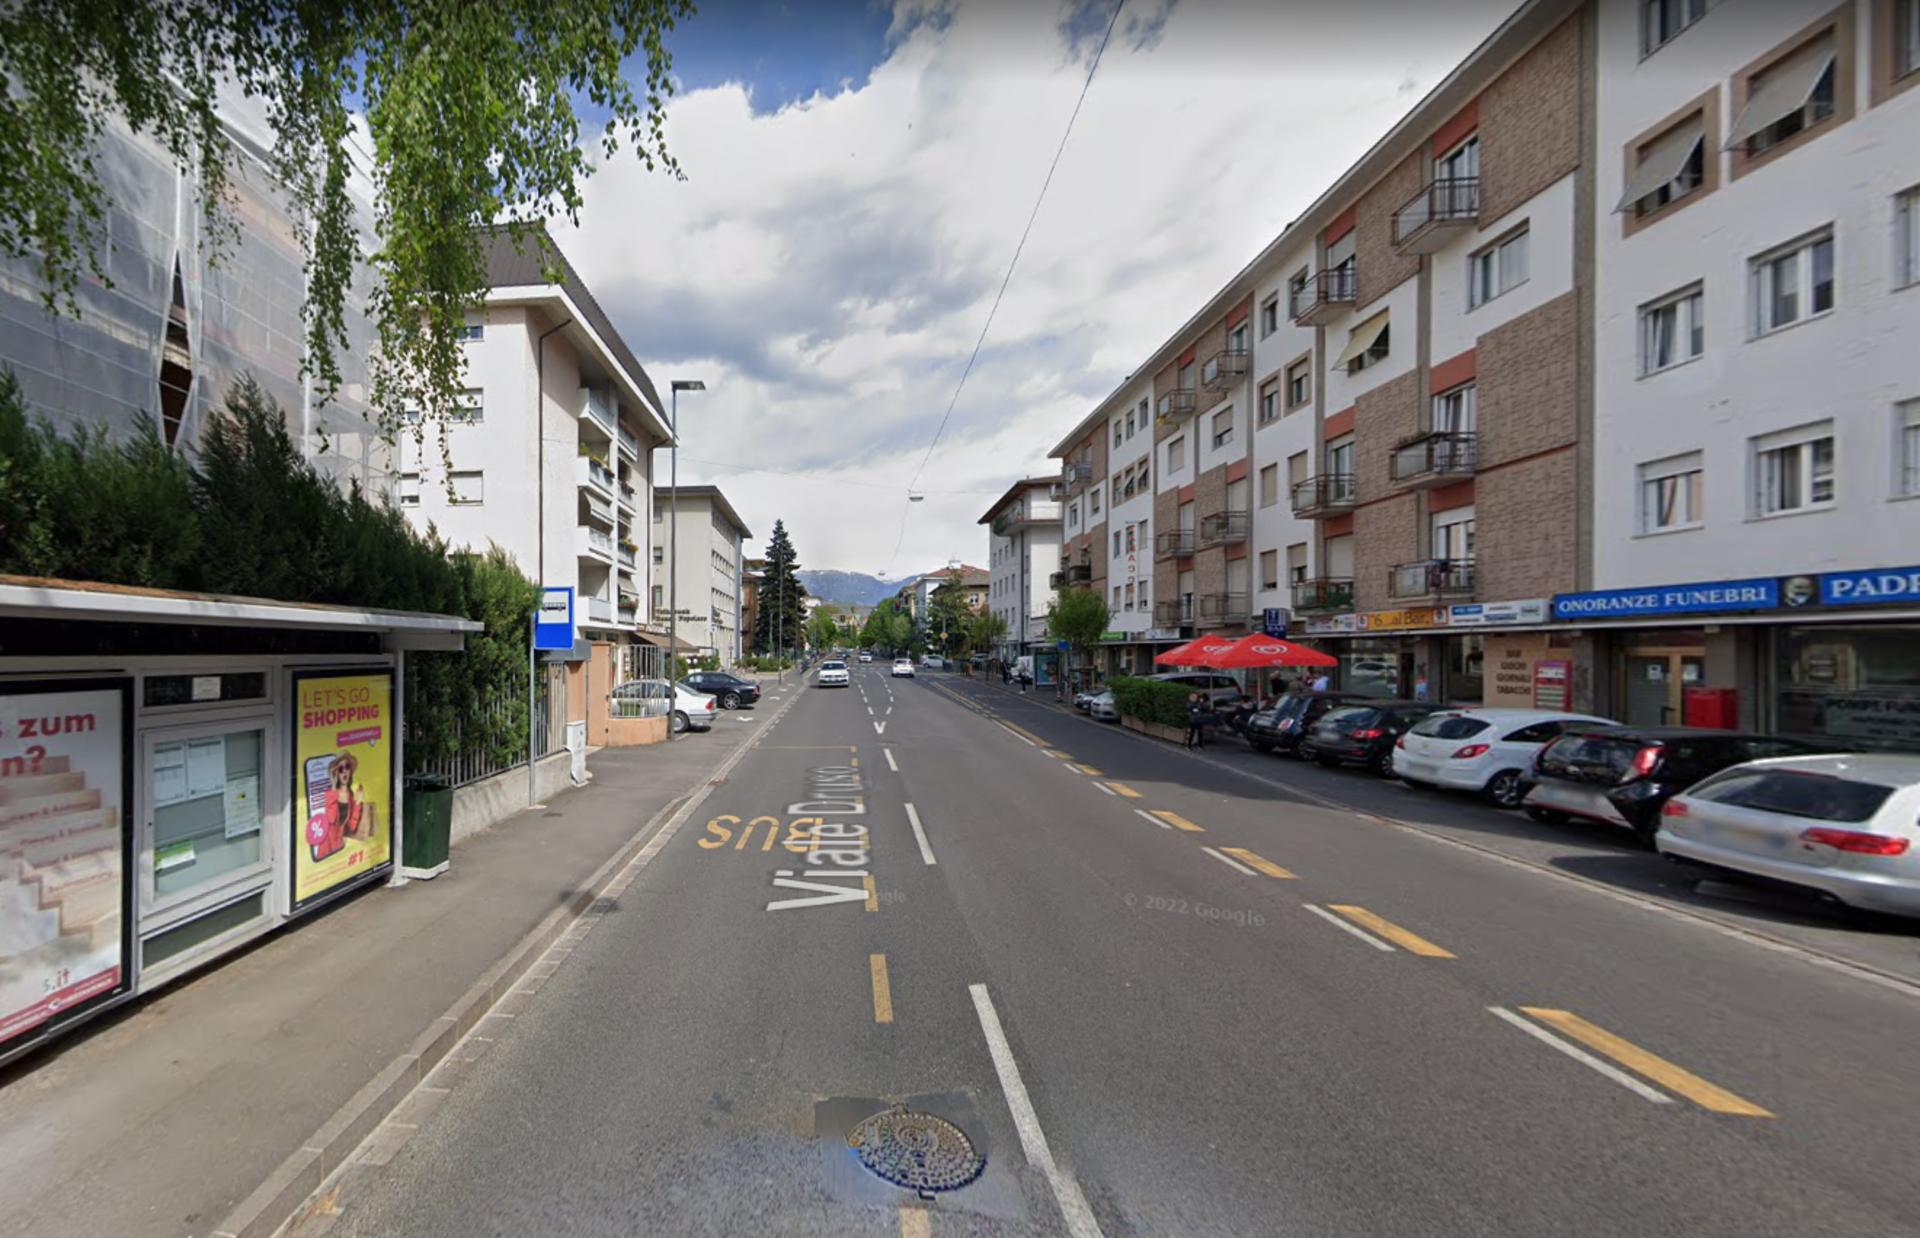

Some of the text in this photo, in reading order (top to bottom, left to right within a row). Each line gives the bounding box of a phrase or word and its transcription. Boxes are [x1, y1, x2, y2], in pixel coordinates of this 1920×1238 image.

[1559, 593, 1659, 612] ONORANZE
[1664, 587, 1767, 607] FUNEBRI
[303, 687, 370, 708] LET'S GO
[18, 713, 96, 738] zum
[303, 704, 379, 728] SHOPPING
[697, 814, 823, 853] BUS
